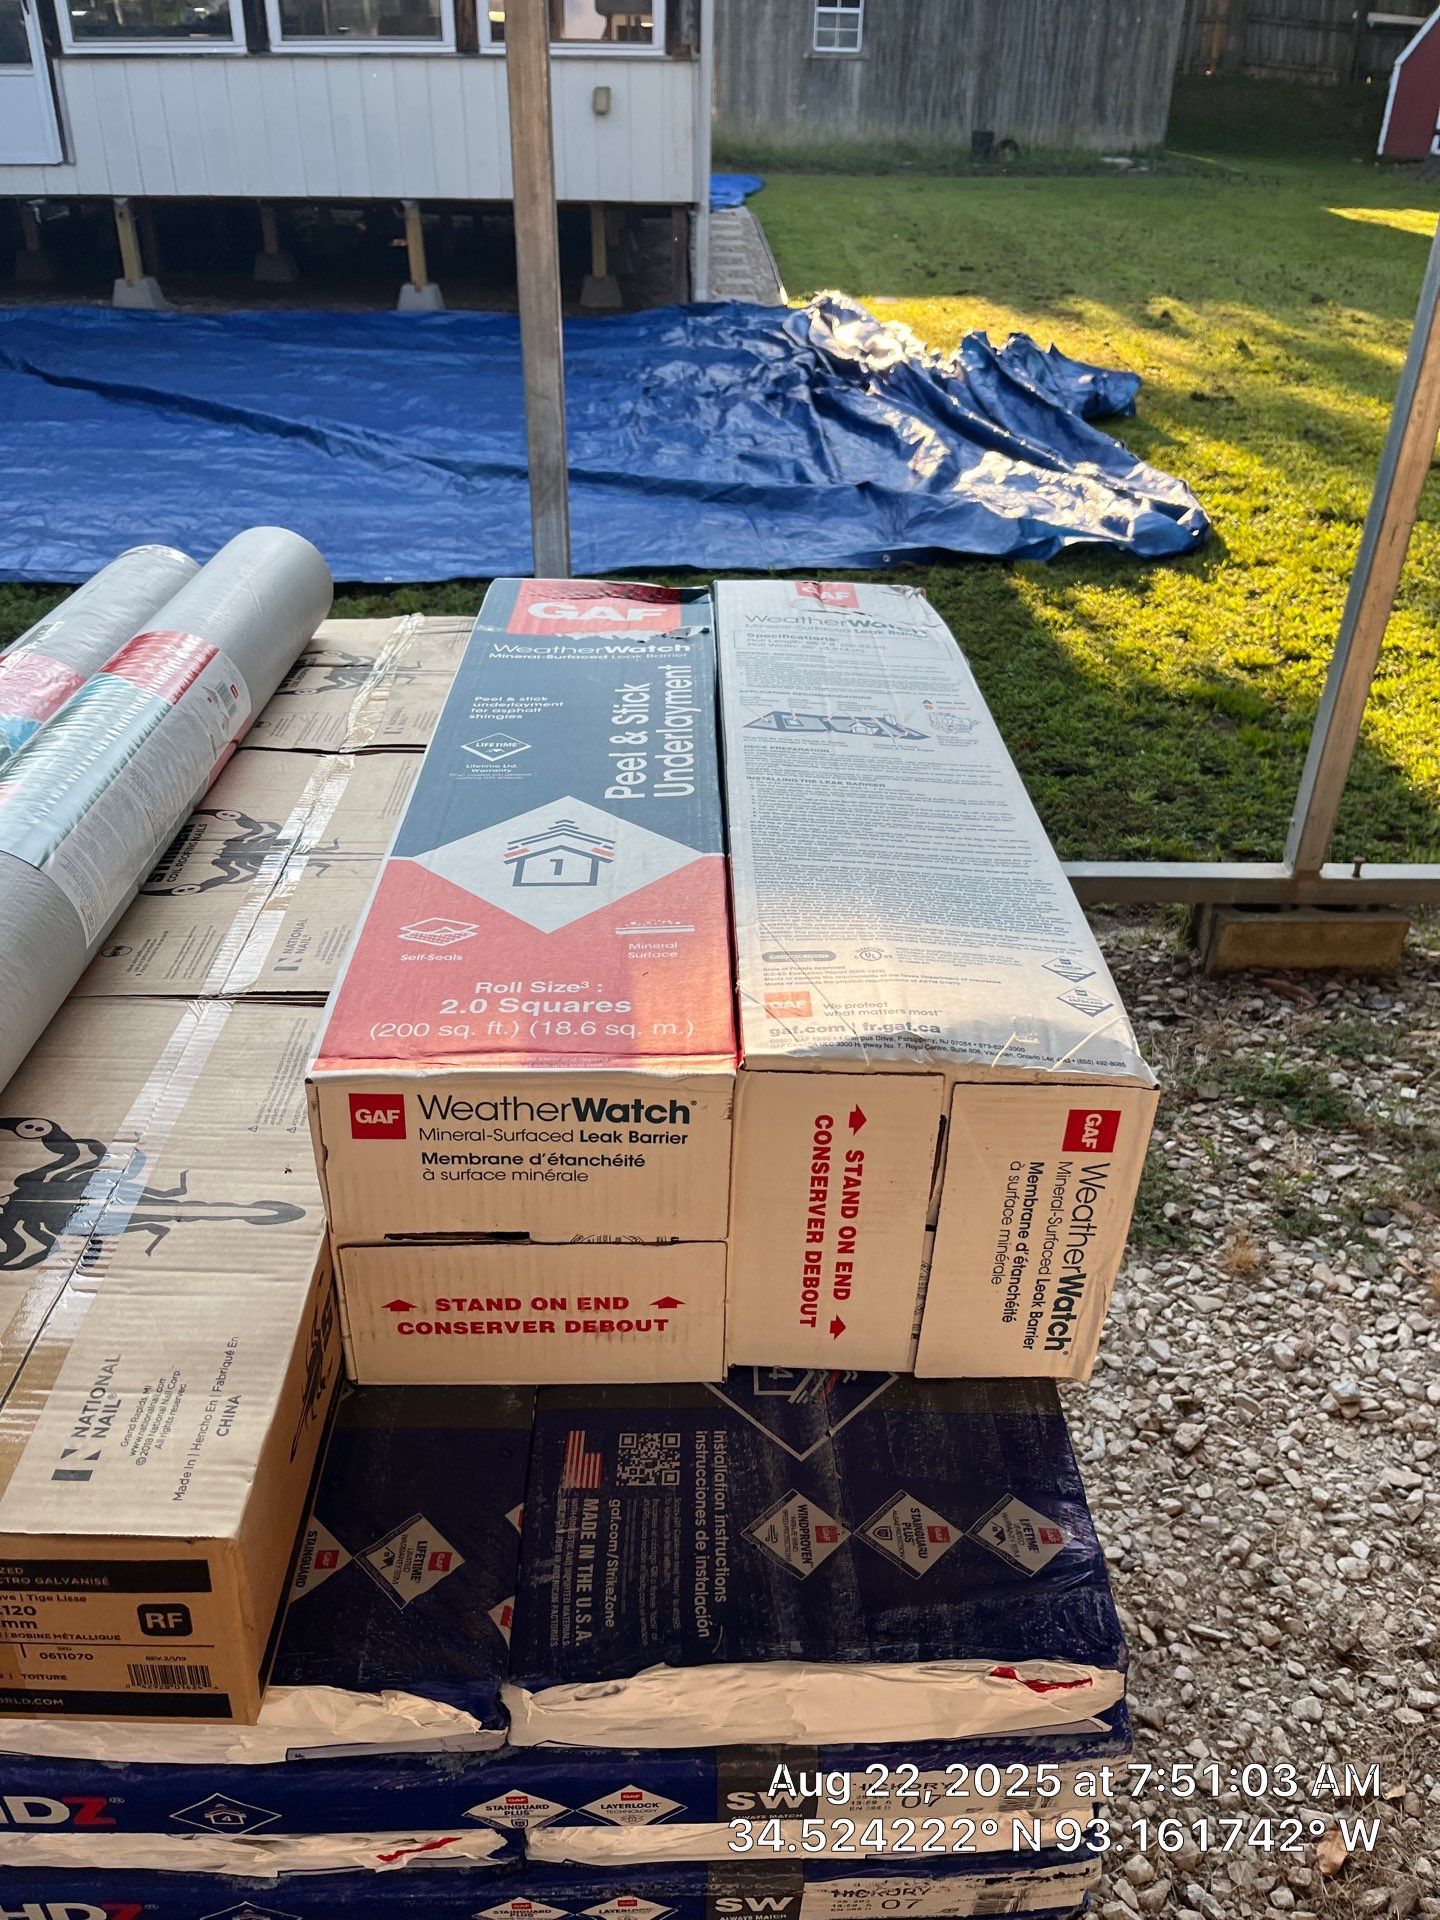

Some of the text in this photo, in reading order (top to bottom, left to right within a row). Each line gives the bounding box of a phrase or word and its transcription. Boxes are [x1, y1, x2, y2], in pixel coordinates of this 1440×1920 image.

[528, 602, 667, 622] GAF
[604, 682, 652, 799] Peel & Stick
[653, 664, 702, 798] Underlayment
[627, 950, 678, 959] Surface
[628, 941, 678, 950] Mineral
[400, 953, 463, 962] Self-Seals
[475, 981, 522, 994] Roll
[439, 997, 632, 1017] 2.0 Squares
[369, 1019, 695, 1040] (200 sq. ft.) (18.6 sq. m.)
[769, 1022, 941, 1036] gaf.com fr.gaf.ca
[354, 1108, 400, 1125] GAF
[419, 1128, 688, 1145] Mineral-Surfaced Leak Barrier
[1081, 1113, 1102, 1149] GAF
[421, 1152, 523, 1166] Membrane
[423, 1168, 589, 1183] à surface minérale
[1018, 1161, 1045, 1240] Membrane
[800, 1115, 834, 1328] CONSERVER DEBOUT
[833, 1150, 865, 1301] STAND ON END
[991, 1161, 1022, 1286] à surface minérale
[1023, 1161, 1074, 1351] Mineral-Surfaced Leak Barrier
[435, 1297, 629, 1312] STAND ON END
[397, 1319, 669, 1335] CONSERVER DEBOUT
[71, 1354, 121, 1438] NATIONAL
[148, 1406, 165, 1437] National
[160, 1391, 172, 1405] Nail
[173, 1337, 239, 1502] Made In Hencho En Fabriqué En
[216, 1395, 241, 1437] CHINA
[120, 1423, 136, 1447] Grand
[155, 1416, 174, 1449] All rights
[713, 1430, 730, 1602] Installation instructions
[296, 1531, 318, 1587] STAINGUARD
[604, 1499, 620, 1628] gaf.com/StrikeZone
[35, 1576, 109, 1585] GALVANISÉ
[575, 1498, 599, 1647] MADE IN THE U.S.A.
[694, 1530, 712, 1638] de instalación
[28, 1594, 53, 1602] Tige
[146, 1612, 183, 1629] RF
[54, 1633, 121, 1641] MÉTALLIQUE
[0, 1796, 116, 1825] DZ
[726, 1792, 807, 1811] SW
[715, 1897, 794, 1912] SW
[882, 1899, 923, 1909] 07
